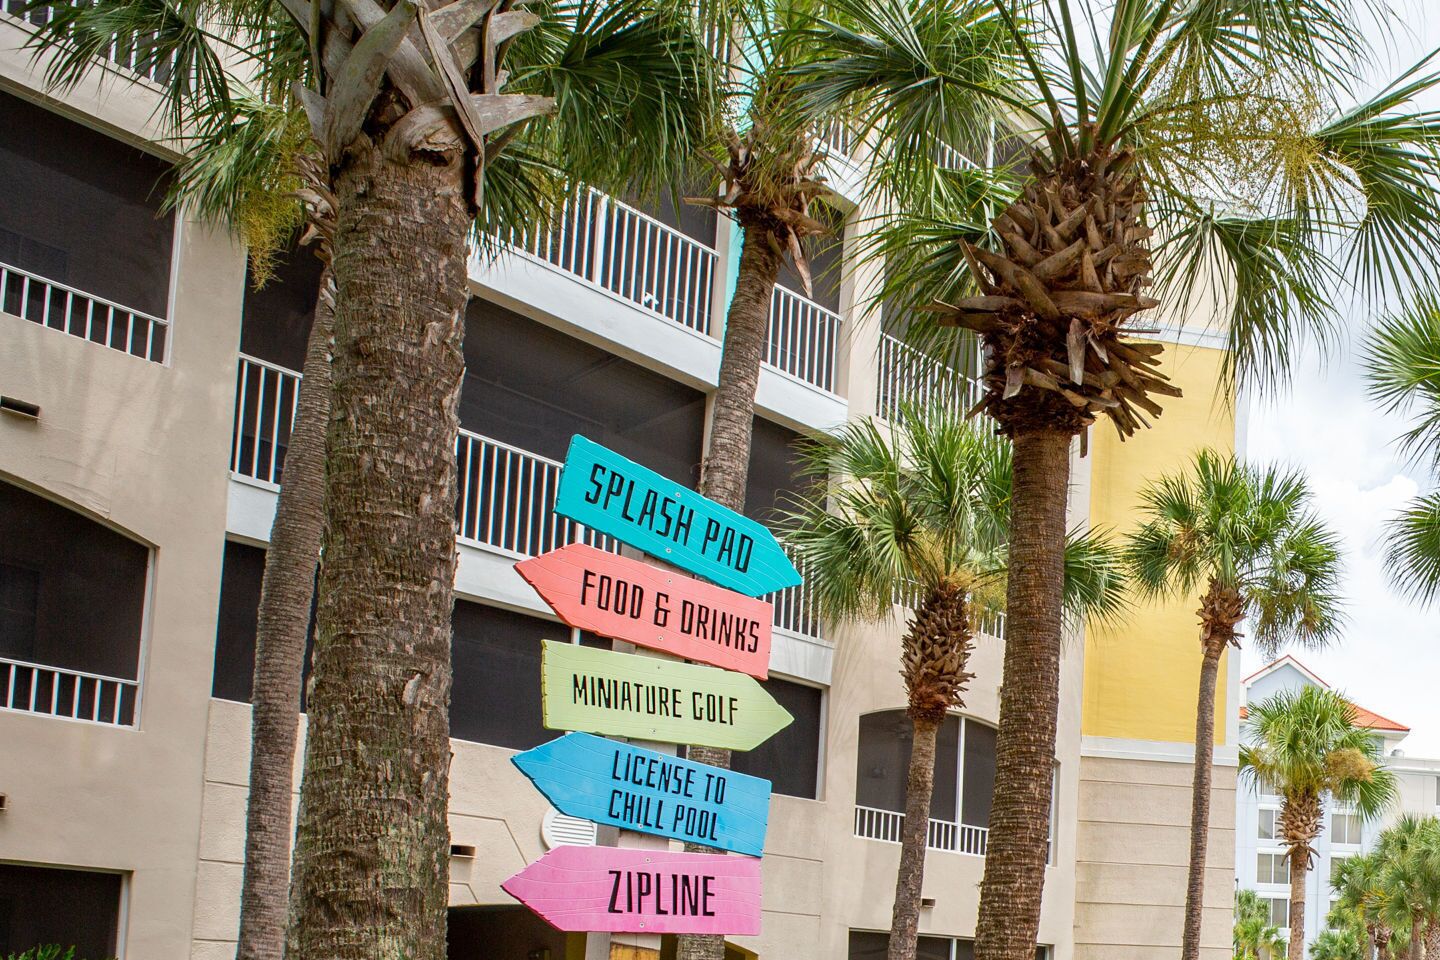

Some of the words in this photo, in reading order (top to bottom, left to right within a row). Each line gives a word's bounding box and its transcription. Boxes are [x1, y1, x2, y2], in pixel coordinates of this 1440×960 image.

[585, 463, 695, 546] SPLASH
[701, 517, 753, 573] PAD
[581, 569, 643, 619] FOOD
[654, 592, 670, 627] &
[681, 600, 759, 653] DRINKS
[573, 674, 682, 718] MINIATURE
[692, 692, 738, 725] GOLF
[612, 750, 696, 797] LICENSE
[704, 773, 726, 804] TO
[608, 790, 663, 829] CHILL
[673, 804, 717, 841] POOL
[608, 870, 715, 916] ZIPLINE
